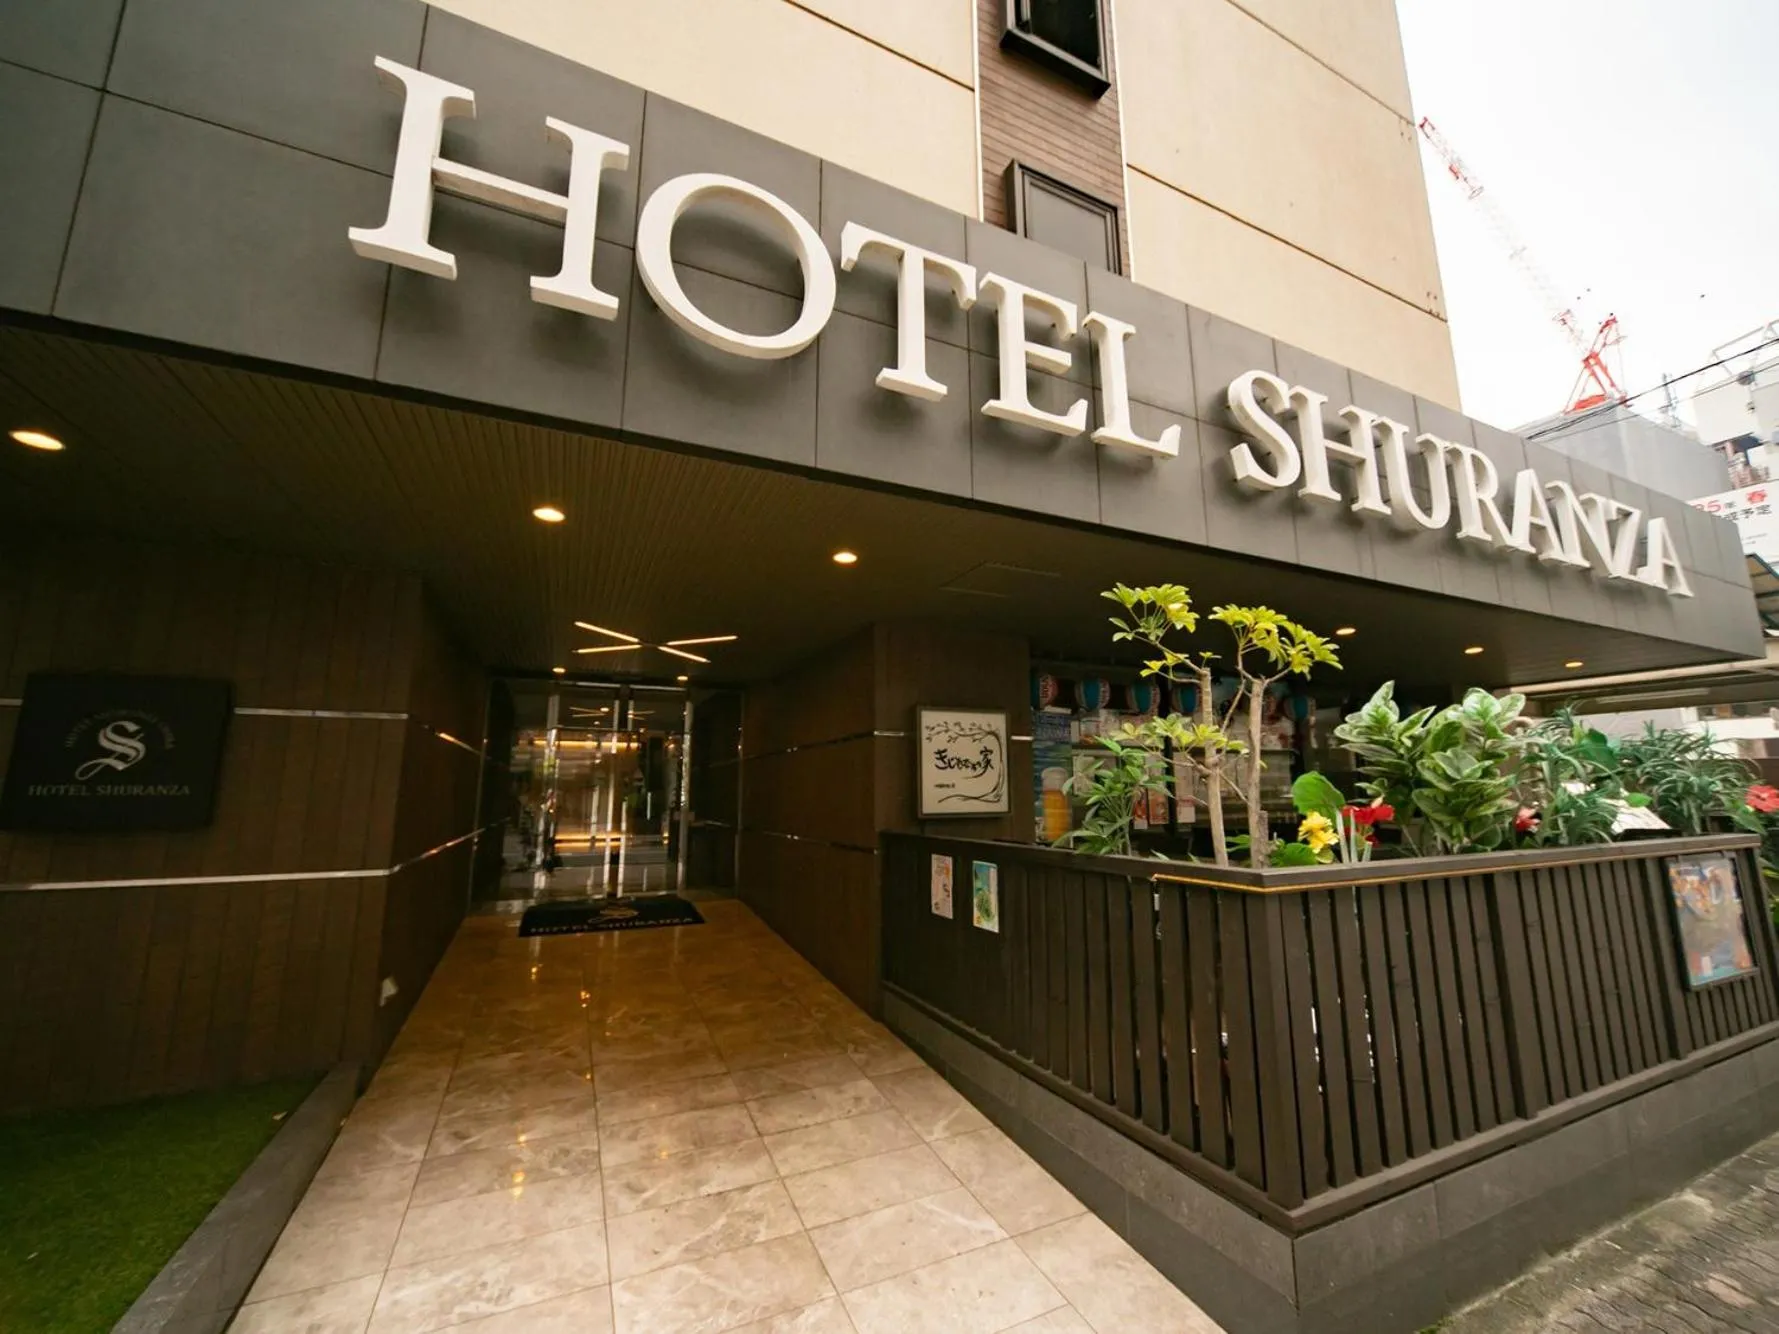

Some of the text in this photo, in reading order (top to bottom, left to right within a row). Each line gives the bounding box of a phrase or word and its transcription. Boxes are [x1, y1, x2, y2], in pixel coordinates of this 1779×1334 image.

[348, 54, 1695, 598] HOTEL SHURANZA
[28, 784, 192, 797] HOTEL SHURANZA
